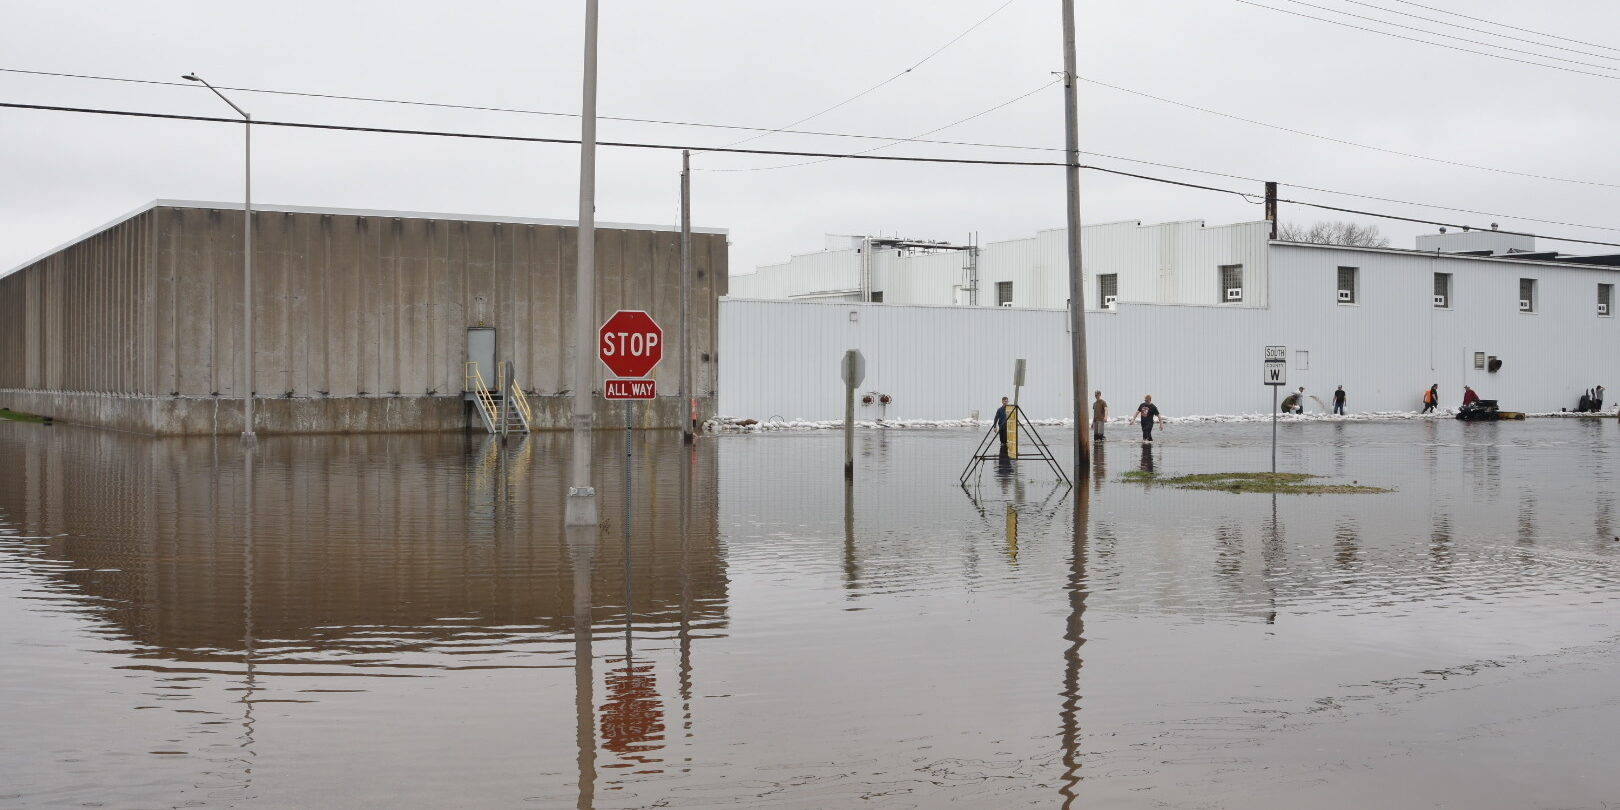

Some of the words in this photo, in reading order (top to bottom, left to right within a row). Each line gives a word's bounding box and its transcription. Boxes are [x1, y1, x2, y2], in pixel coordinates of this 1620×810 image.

[603, 332, 658, 357] STOP
[1266, 348, 1285, 357] SOUTH
[1270, 369, 1280, 381] W
[607, 383, 628, 396] ALL
[631, 383, 653, 396] WAY
